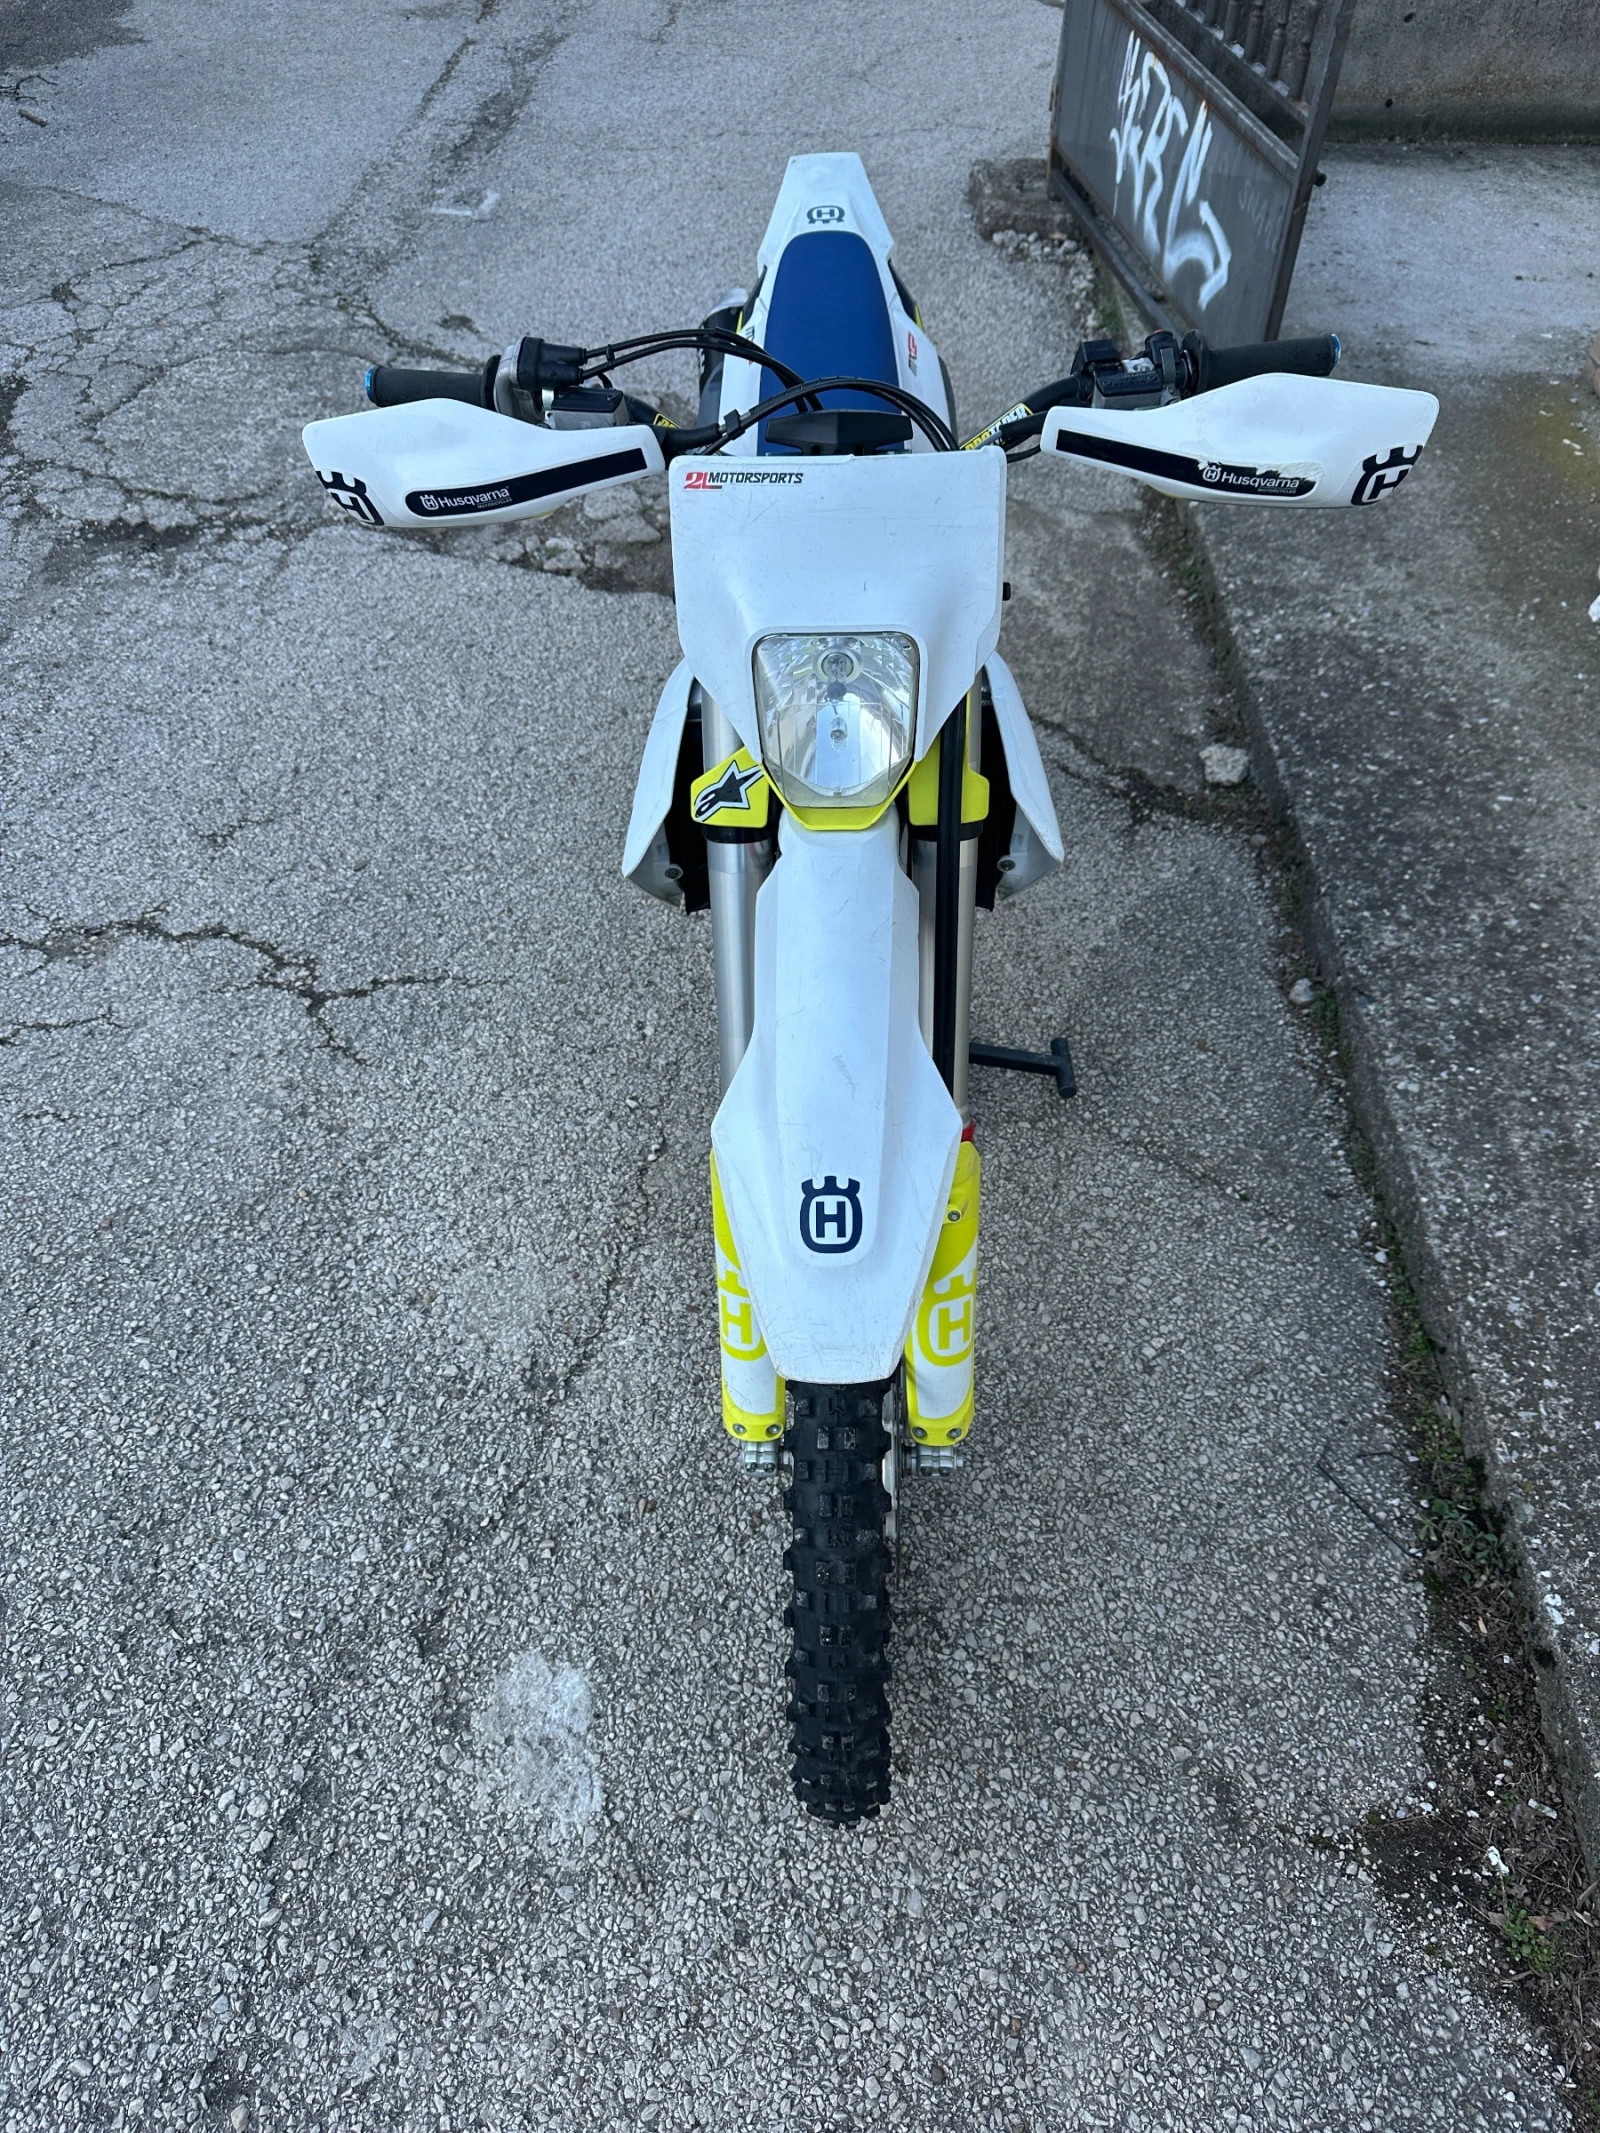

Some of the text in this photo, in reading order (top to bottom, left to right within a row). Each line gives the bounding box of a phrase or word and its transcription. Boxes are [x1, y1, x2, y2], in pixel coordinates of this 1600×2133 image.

[708, 472, 803, 484] MOTORSPORTS
[1221, 471, 1299, 488] Husqvarna
[438, 488, 509, 507] Husqvarna
